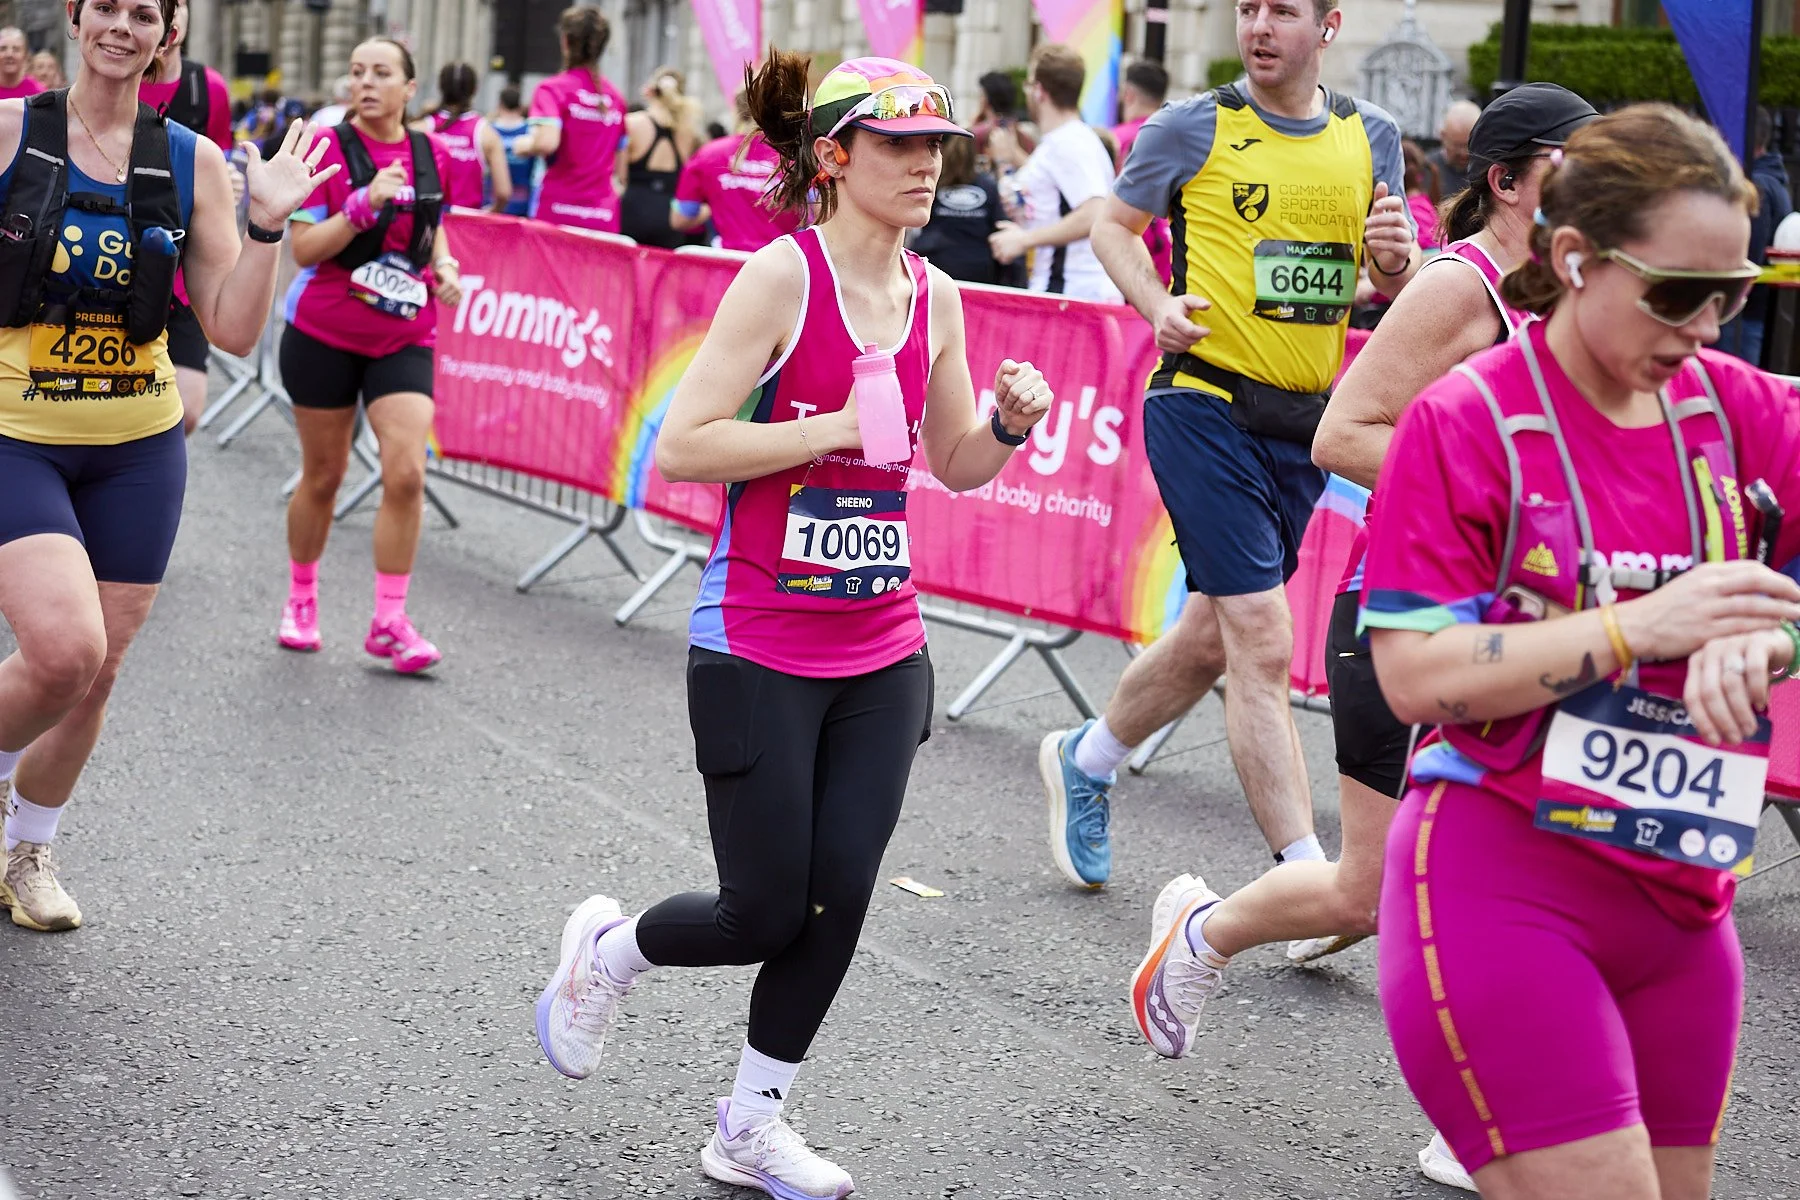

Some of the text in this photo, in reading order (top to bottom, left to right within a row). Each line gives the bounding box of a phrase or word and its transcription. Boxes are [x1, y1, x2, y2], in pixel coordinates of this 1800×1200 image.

[1280, 198, 1337, 212] SPORTS
[1286, 245, 1333, 256] MALCOLM
[1270, 265, 1344, 296] 6644
[75, 312, 124, 324] PREBBLE
[453, 274, 614, 368] Tommy's
[50, 333, 136, 366] 4266
[835, 496, 873, 509] SHEENO
[996, 480, 1041, 514] baby
[1044, 488, 1112, 527] charity
[798, 522, 901, 560] 10069
[1580, 729, 1726, 808] 9204
